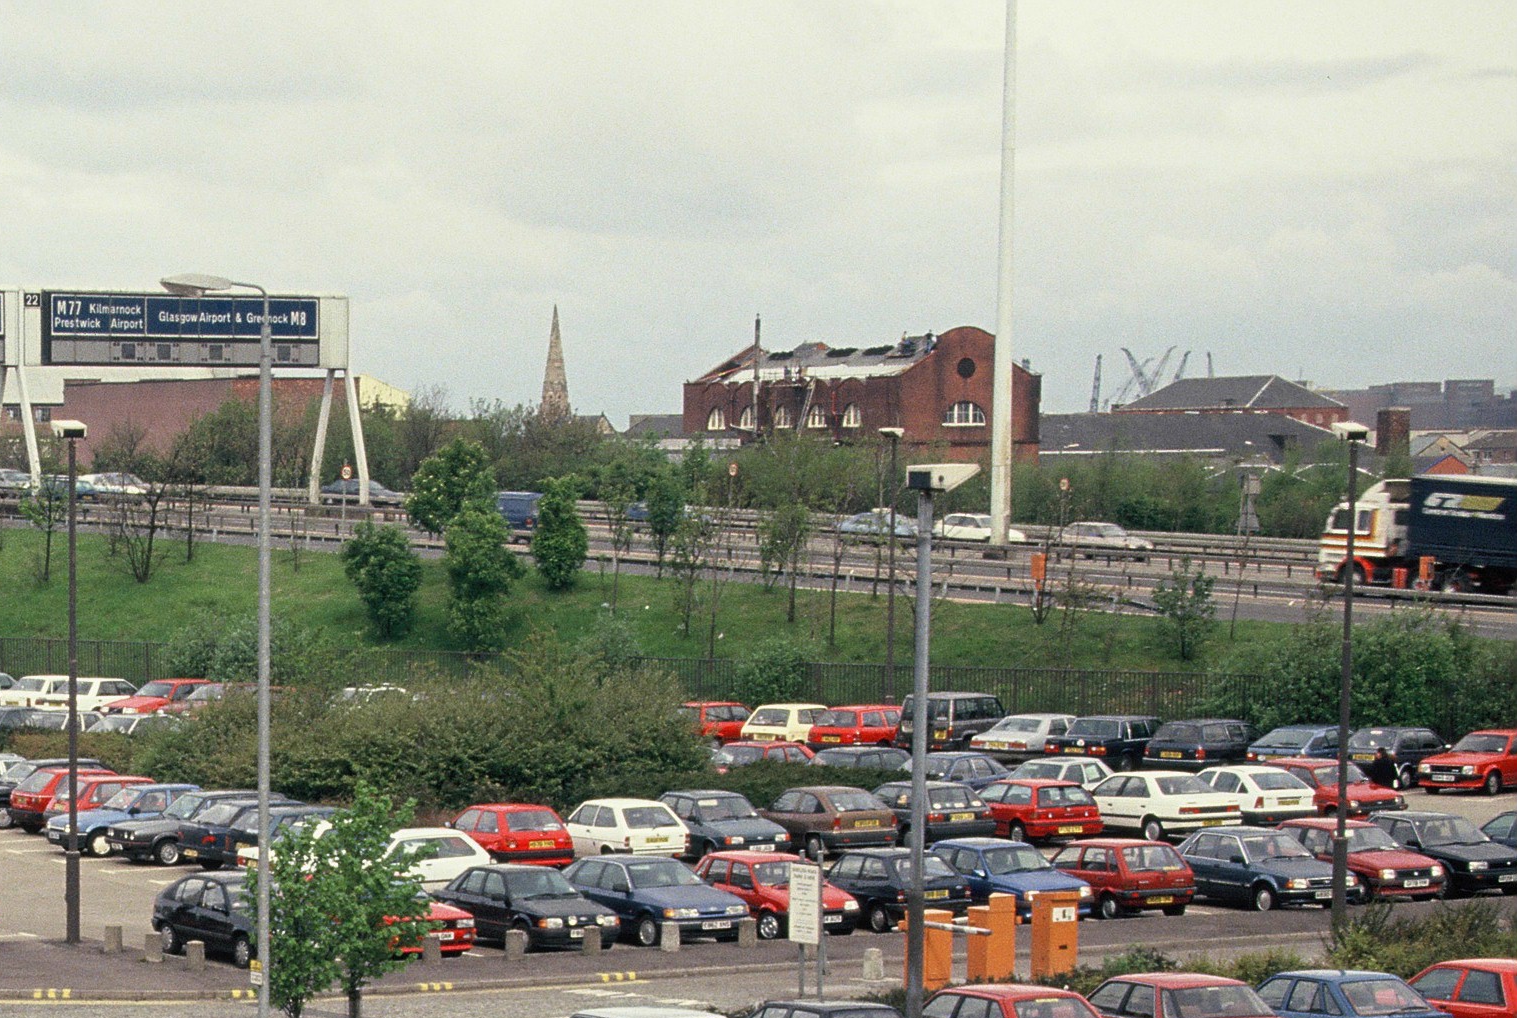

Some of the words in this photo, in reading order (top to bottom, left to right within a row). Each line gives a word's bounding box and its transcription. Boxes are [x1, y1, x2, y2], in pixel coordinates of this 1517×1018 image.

[26, 294, 39, 306] 22
[56, 300, 82, 315] M77
[89, 302, 142, 315] Kilmarnock
[54, 316, 102, 330] Prestwick
[110, 317, 144, 331] Airport
[158, 310, 198, 326] Glasgow
[198, 312, 232, 327] Airport
[235, 312, 243, 323] &
[290, 311, 307, 326] M8
